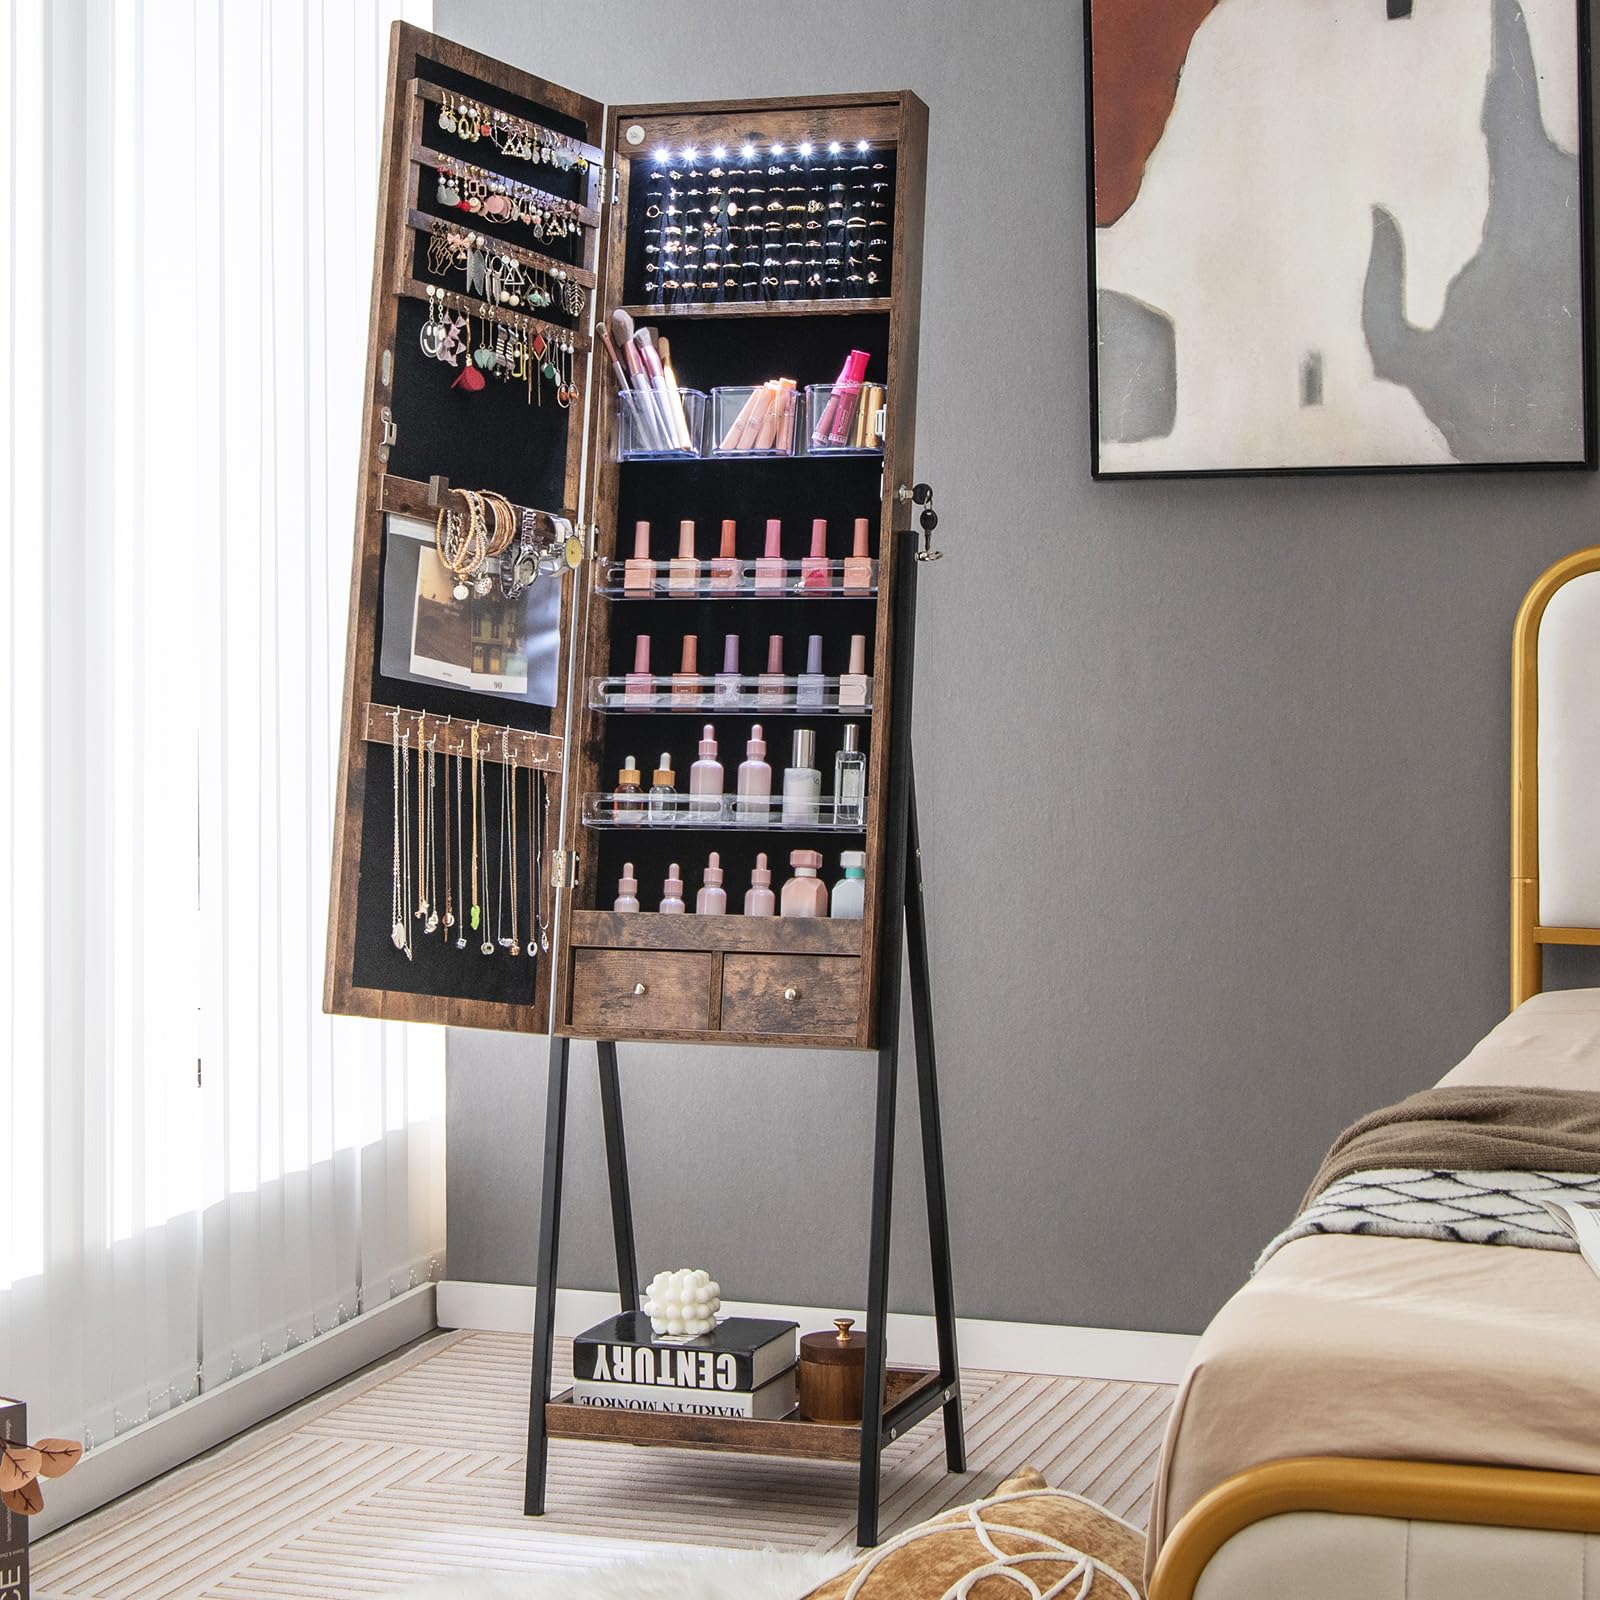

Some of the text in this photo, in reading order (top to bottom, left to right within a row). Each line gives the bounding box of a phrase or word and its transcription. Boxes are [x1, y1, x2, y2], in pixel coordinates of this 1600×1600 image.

[592, 1344, 737, 1391] CENTURY
[581, 1395, 745, 1417] MARILYN MONROE
